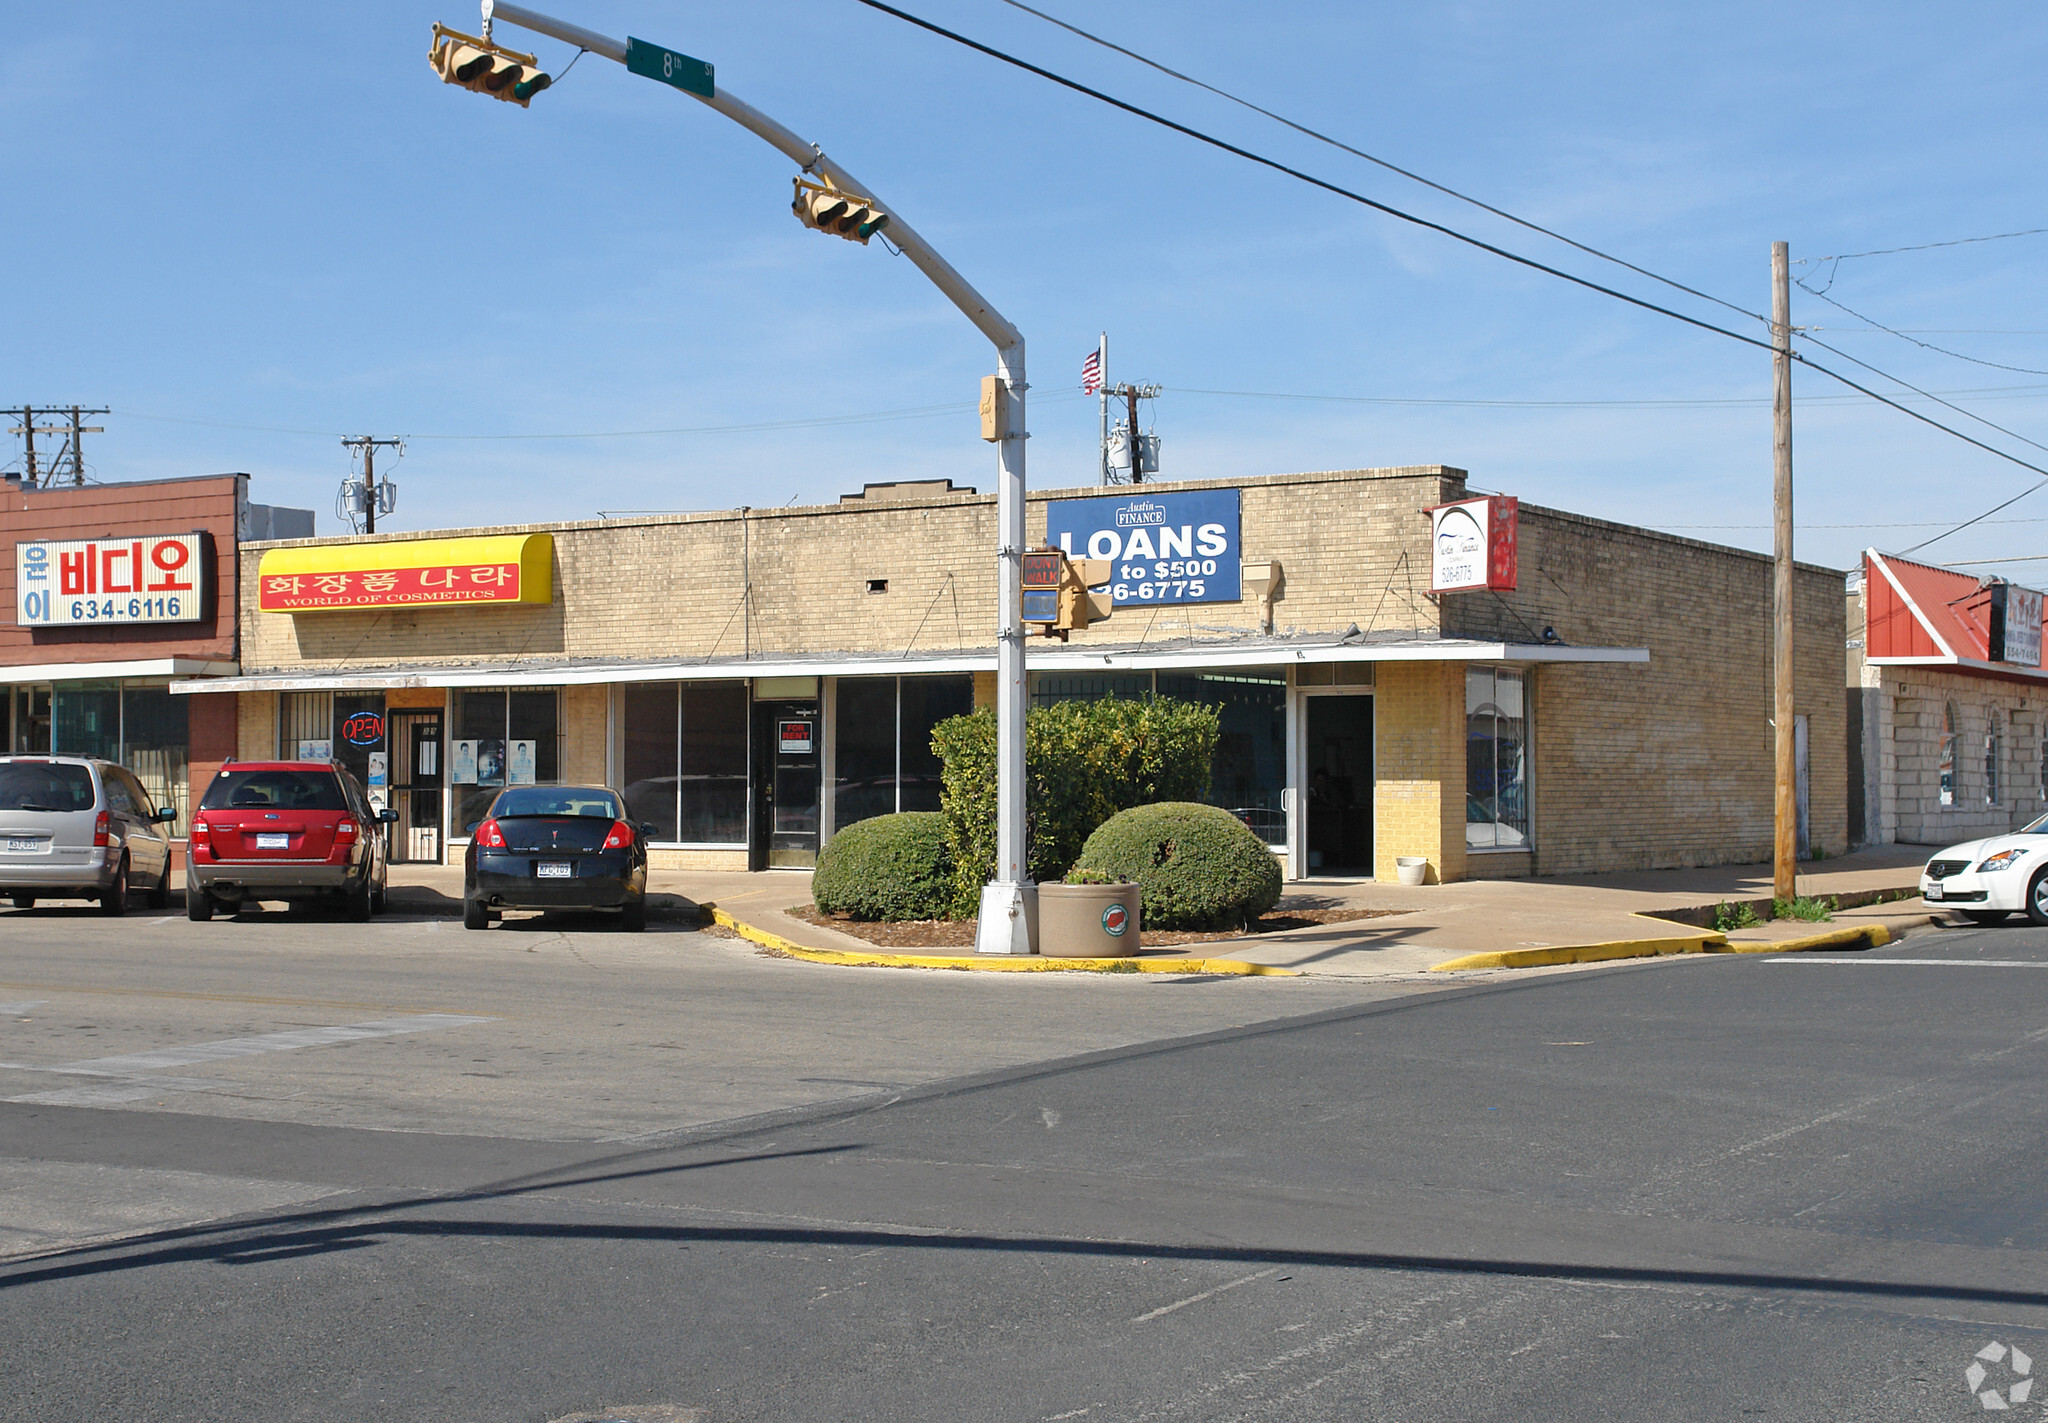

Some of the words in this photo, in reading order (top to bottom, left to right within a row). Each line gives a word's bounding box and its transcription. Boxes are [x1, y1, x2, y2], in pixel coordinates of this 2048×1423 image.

[626, 37, 634, 51] N
[663, 52, 682, 78] 8th
[1127, 501, 1154, 513] Austin
[1119, 511, 1163, 525] FINANCE
[1060, 523, 1228, 561] LOANS
[60, 540, 193, 596] 비디오
[1026, 571, 1058, 584] WALK
[1120, 563, 1146, 580] to
[1154, 559, 1217, 580] $500
[266, 571, 399, 596] 화장품
[420, 566, 512, 588] 나라
[283, 596, 352, 607] WORLD
[356, 594, 382, 604] OF
[386, 590, 495, 603] COSMETICS
[1025, 596, 1056, 613] WALK
[71, 597, 181, 620] 634-6116
[342, 717, 386, 740] OPEN
[782, 731, 809, 740] RENT
[786, 724, 805, 732] FOR
